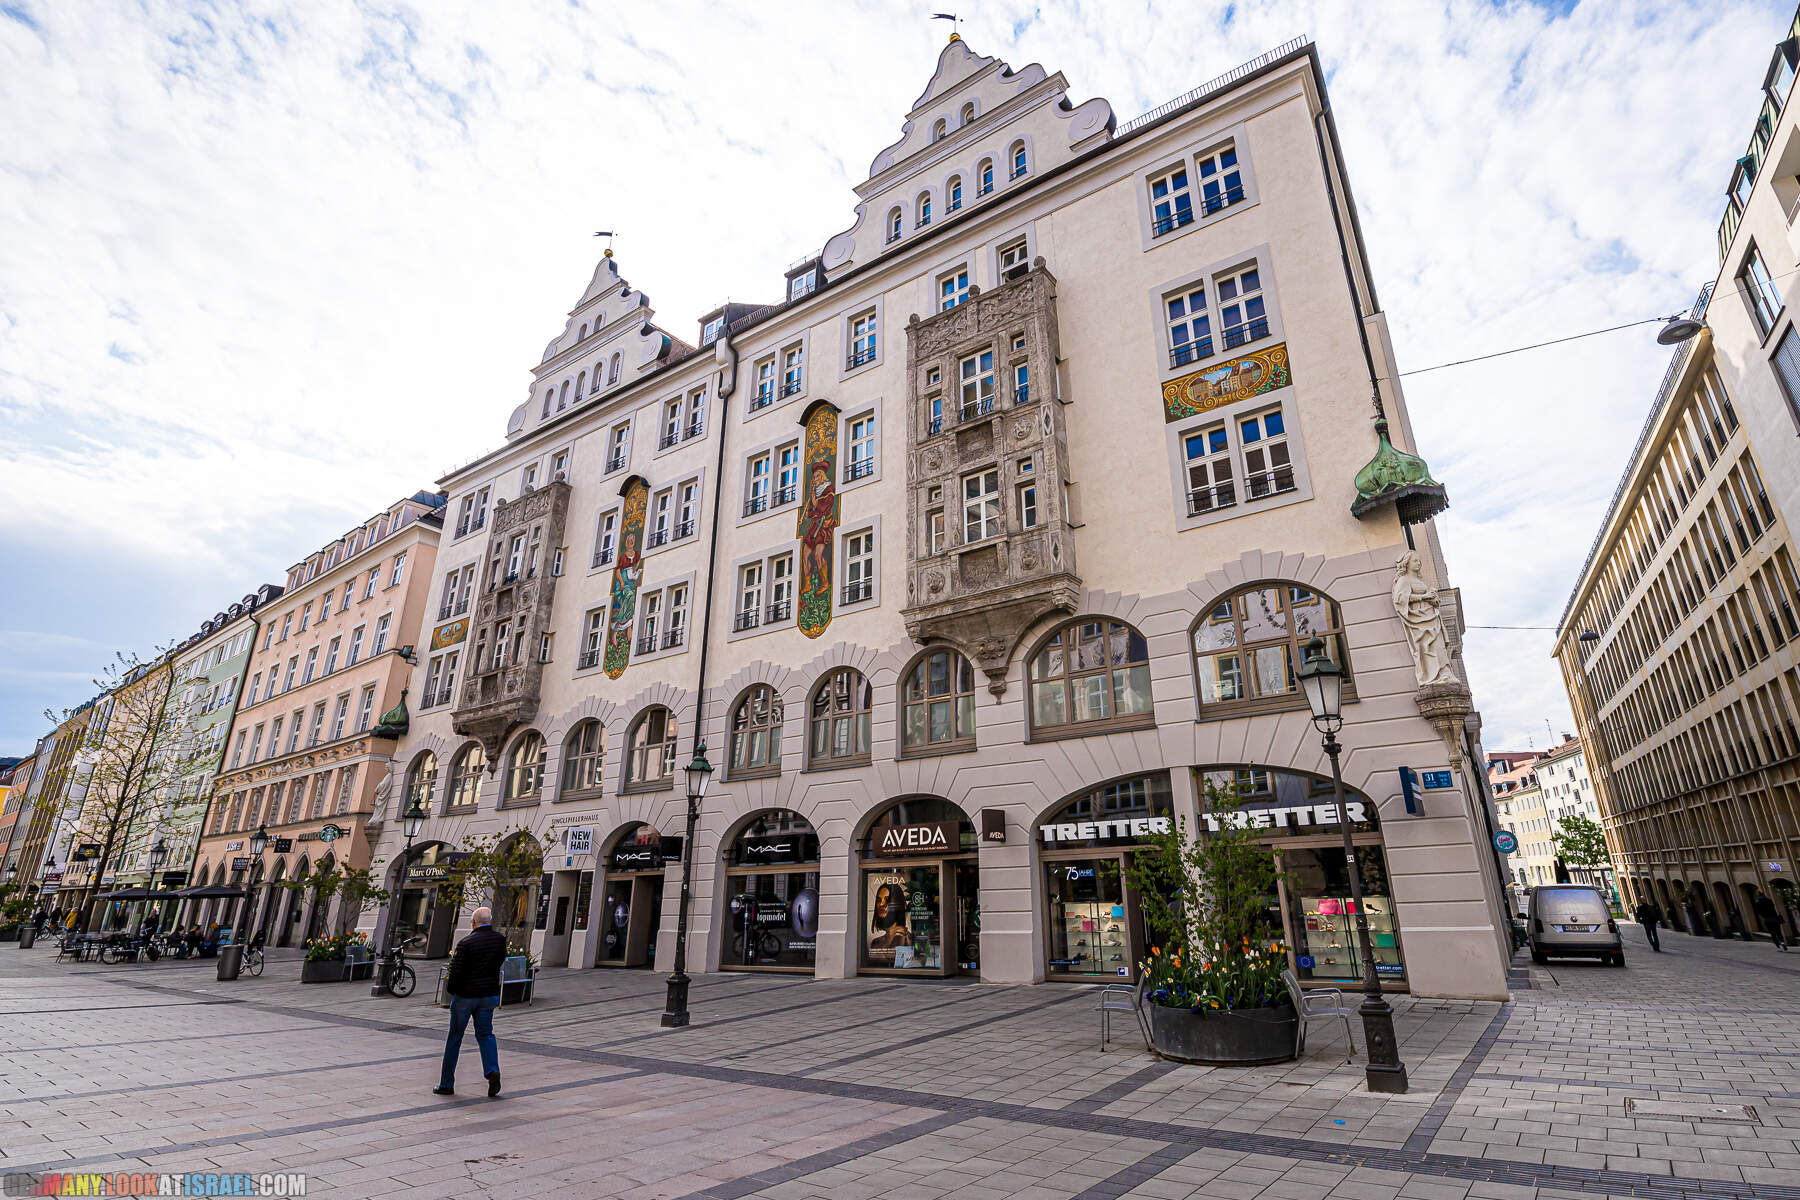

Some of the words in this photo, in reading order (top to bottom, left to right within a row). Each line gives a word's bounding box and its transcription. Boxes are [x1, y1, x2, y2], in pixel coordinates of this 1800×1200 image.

[1424, 773, 1435, 782] 31
[1202, 802, 1368, 832] TRETTER
[1040, 816, 1172, 842] TRETTER
[571, 830, 591, 841] NEW
[882, 825, 947, 848] AVEDA
[570, 840, 589, 851] HAIR
[409, 868, 425, 877] Marc
[1065, 866, 1079, 880] 75
[874, 876, 906, 885] AVEDA
[757, 912, 786, 923] topmodel
